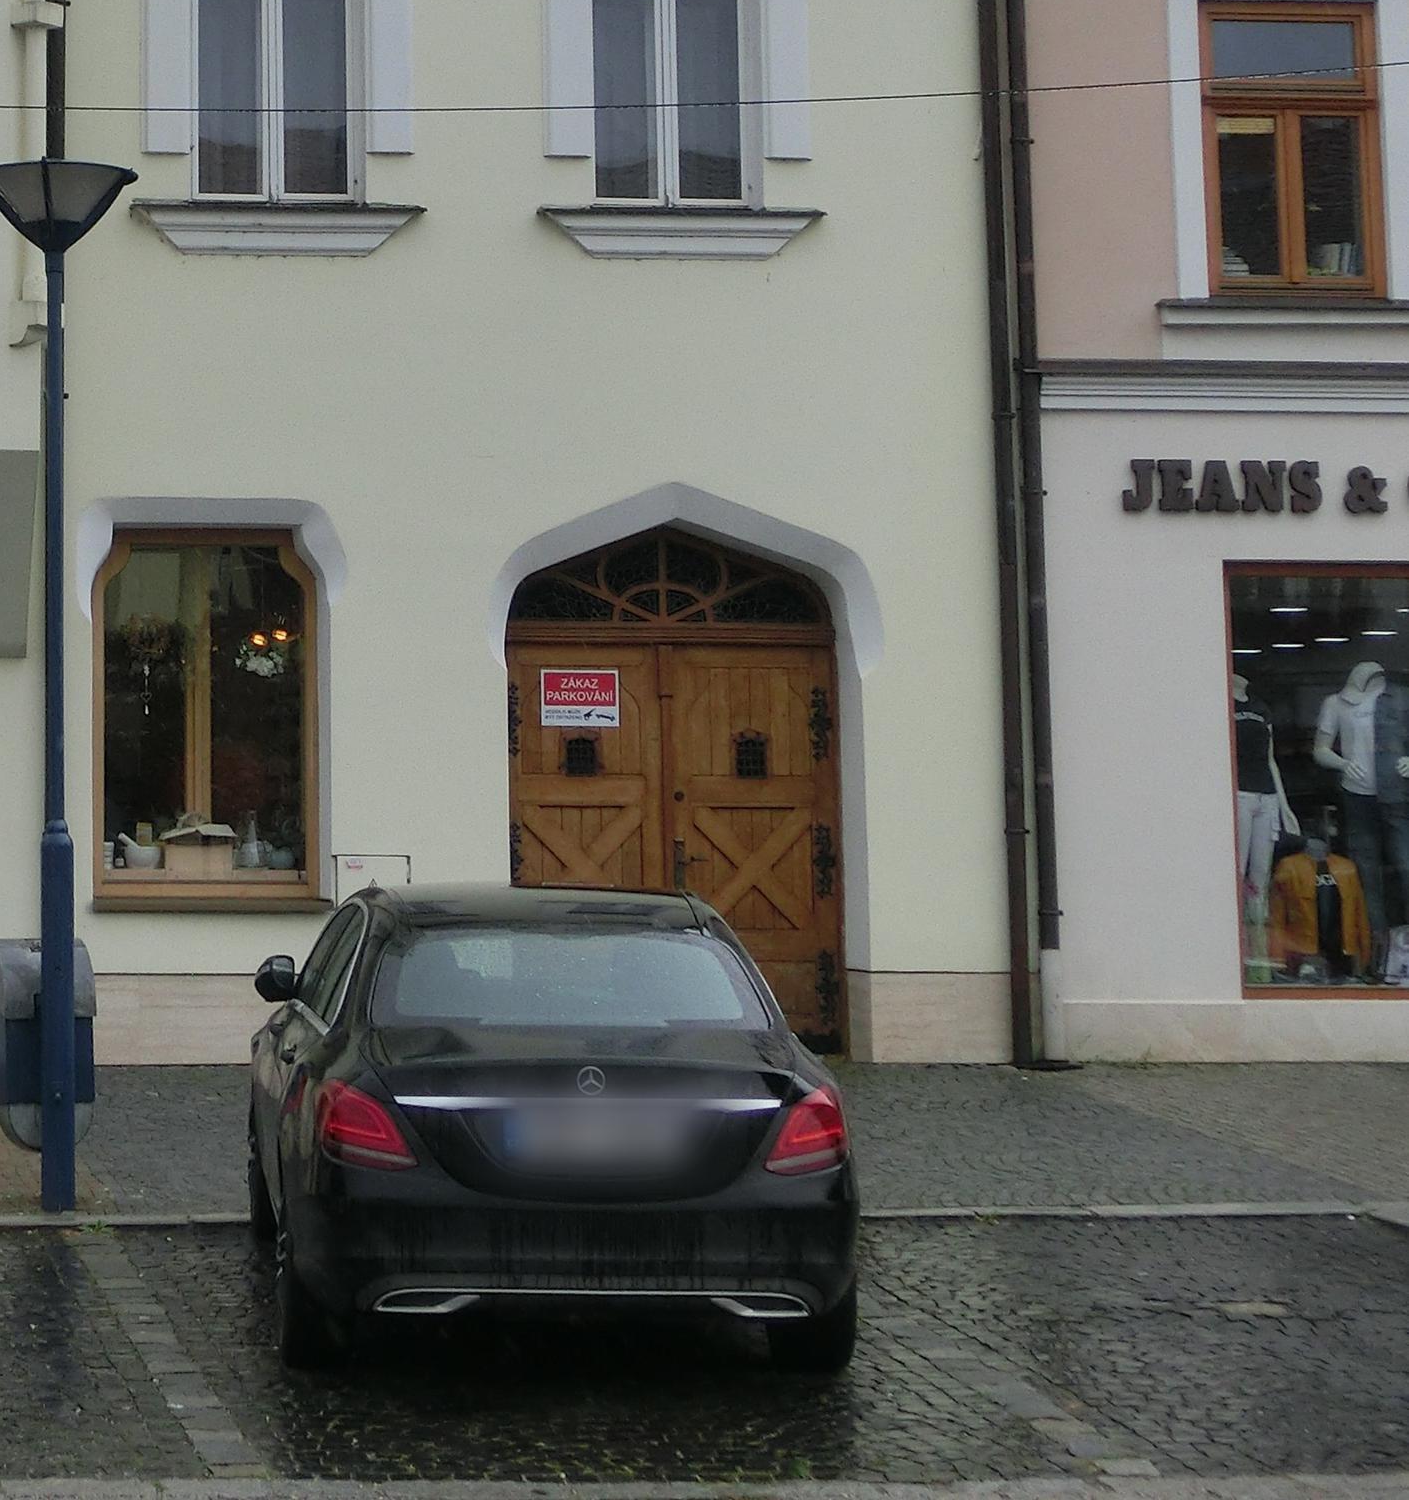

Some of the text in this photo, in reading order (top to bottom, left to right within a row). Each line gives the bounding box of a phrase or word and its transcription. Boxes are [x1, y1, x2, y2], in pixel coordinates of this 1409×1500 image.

[1122, 458, 1322, 514] JEANS
[1343, 465, 1388, 514] &
[560, 676, 599, 689] ZÁKAZ
[546, 690, 614, 702] PARKOVÁNÍ
